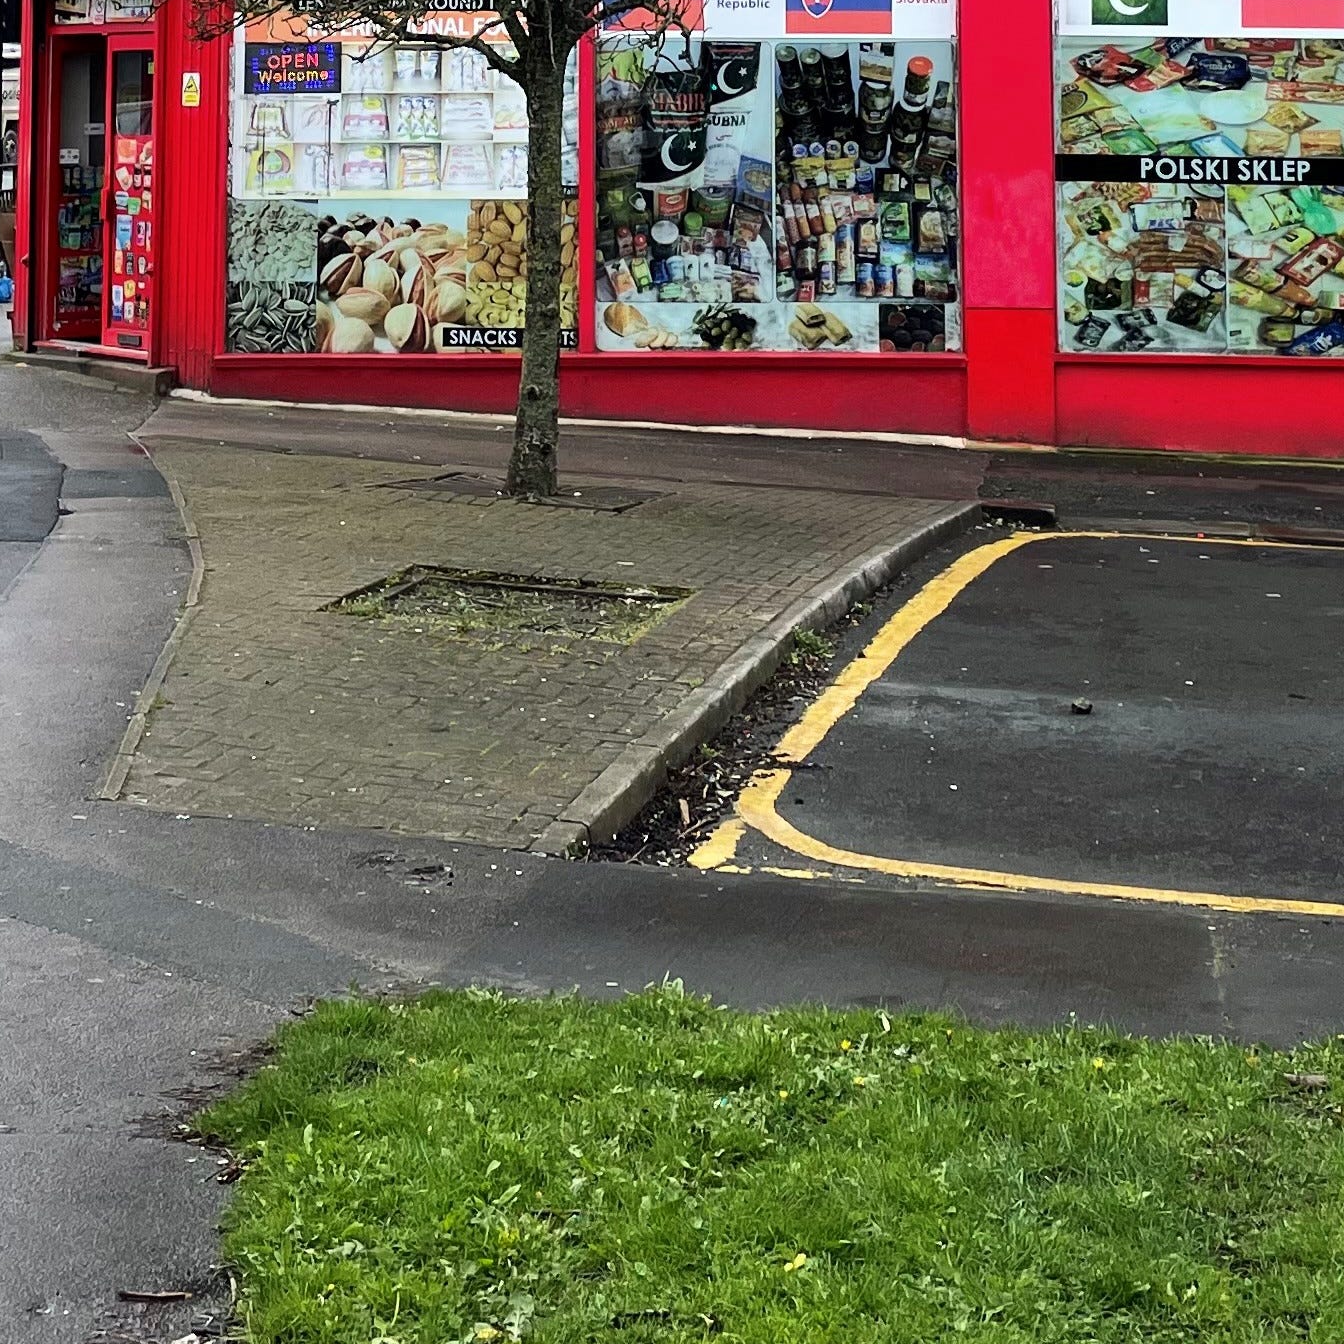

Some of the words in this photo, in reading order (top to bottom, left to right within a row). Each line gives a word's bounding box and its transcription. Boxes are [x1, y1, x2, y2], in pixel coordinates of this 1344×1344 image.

[267, 52, 319, 69] OPEN
[256, 69, 329, 84] Welcome
[1140, 158, 1229, 181] POLSKI
[1238, 159, 1311, 182] SKLEP
[449, 330, 517, 346] SNACKS
